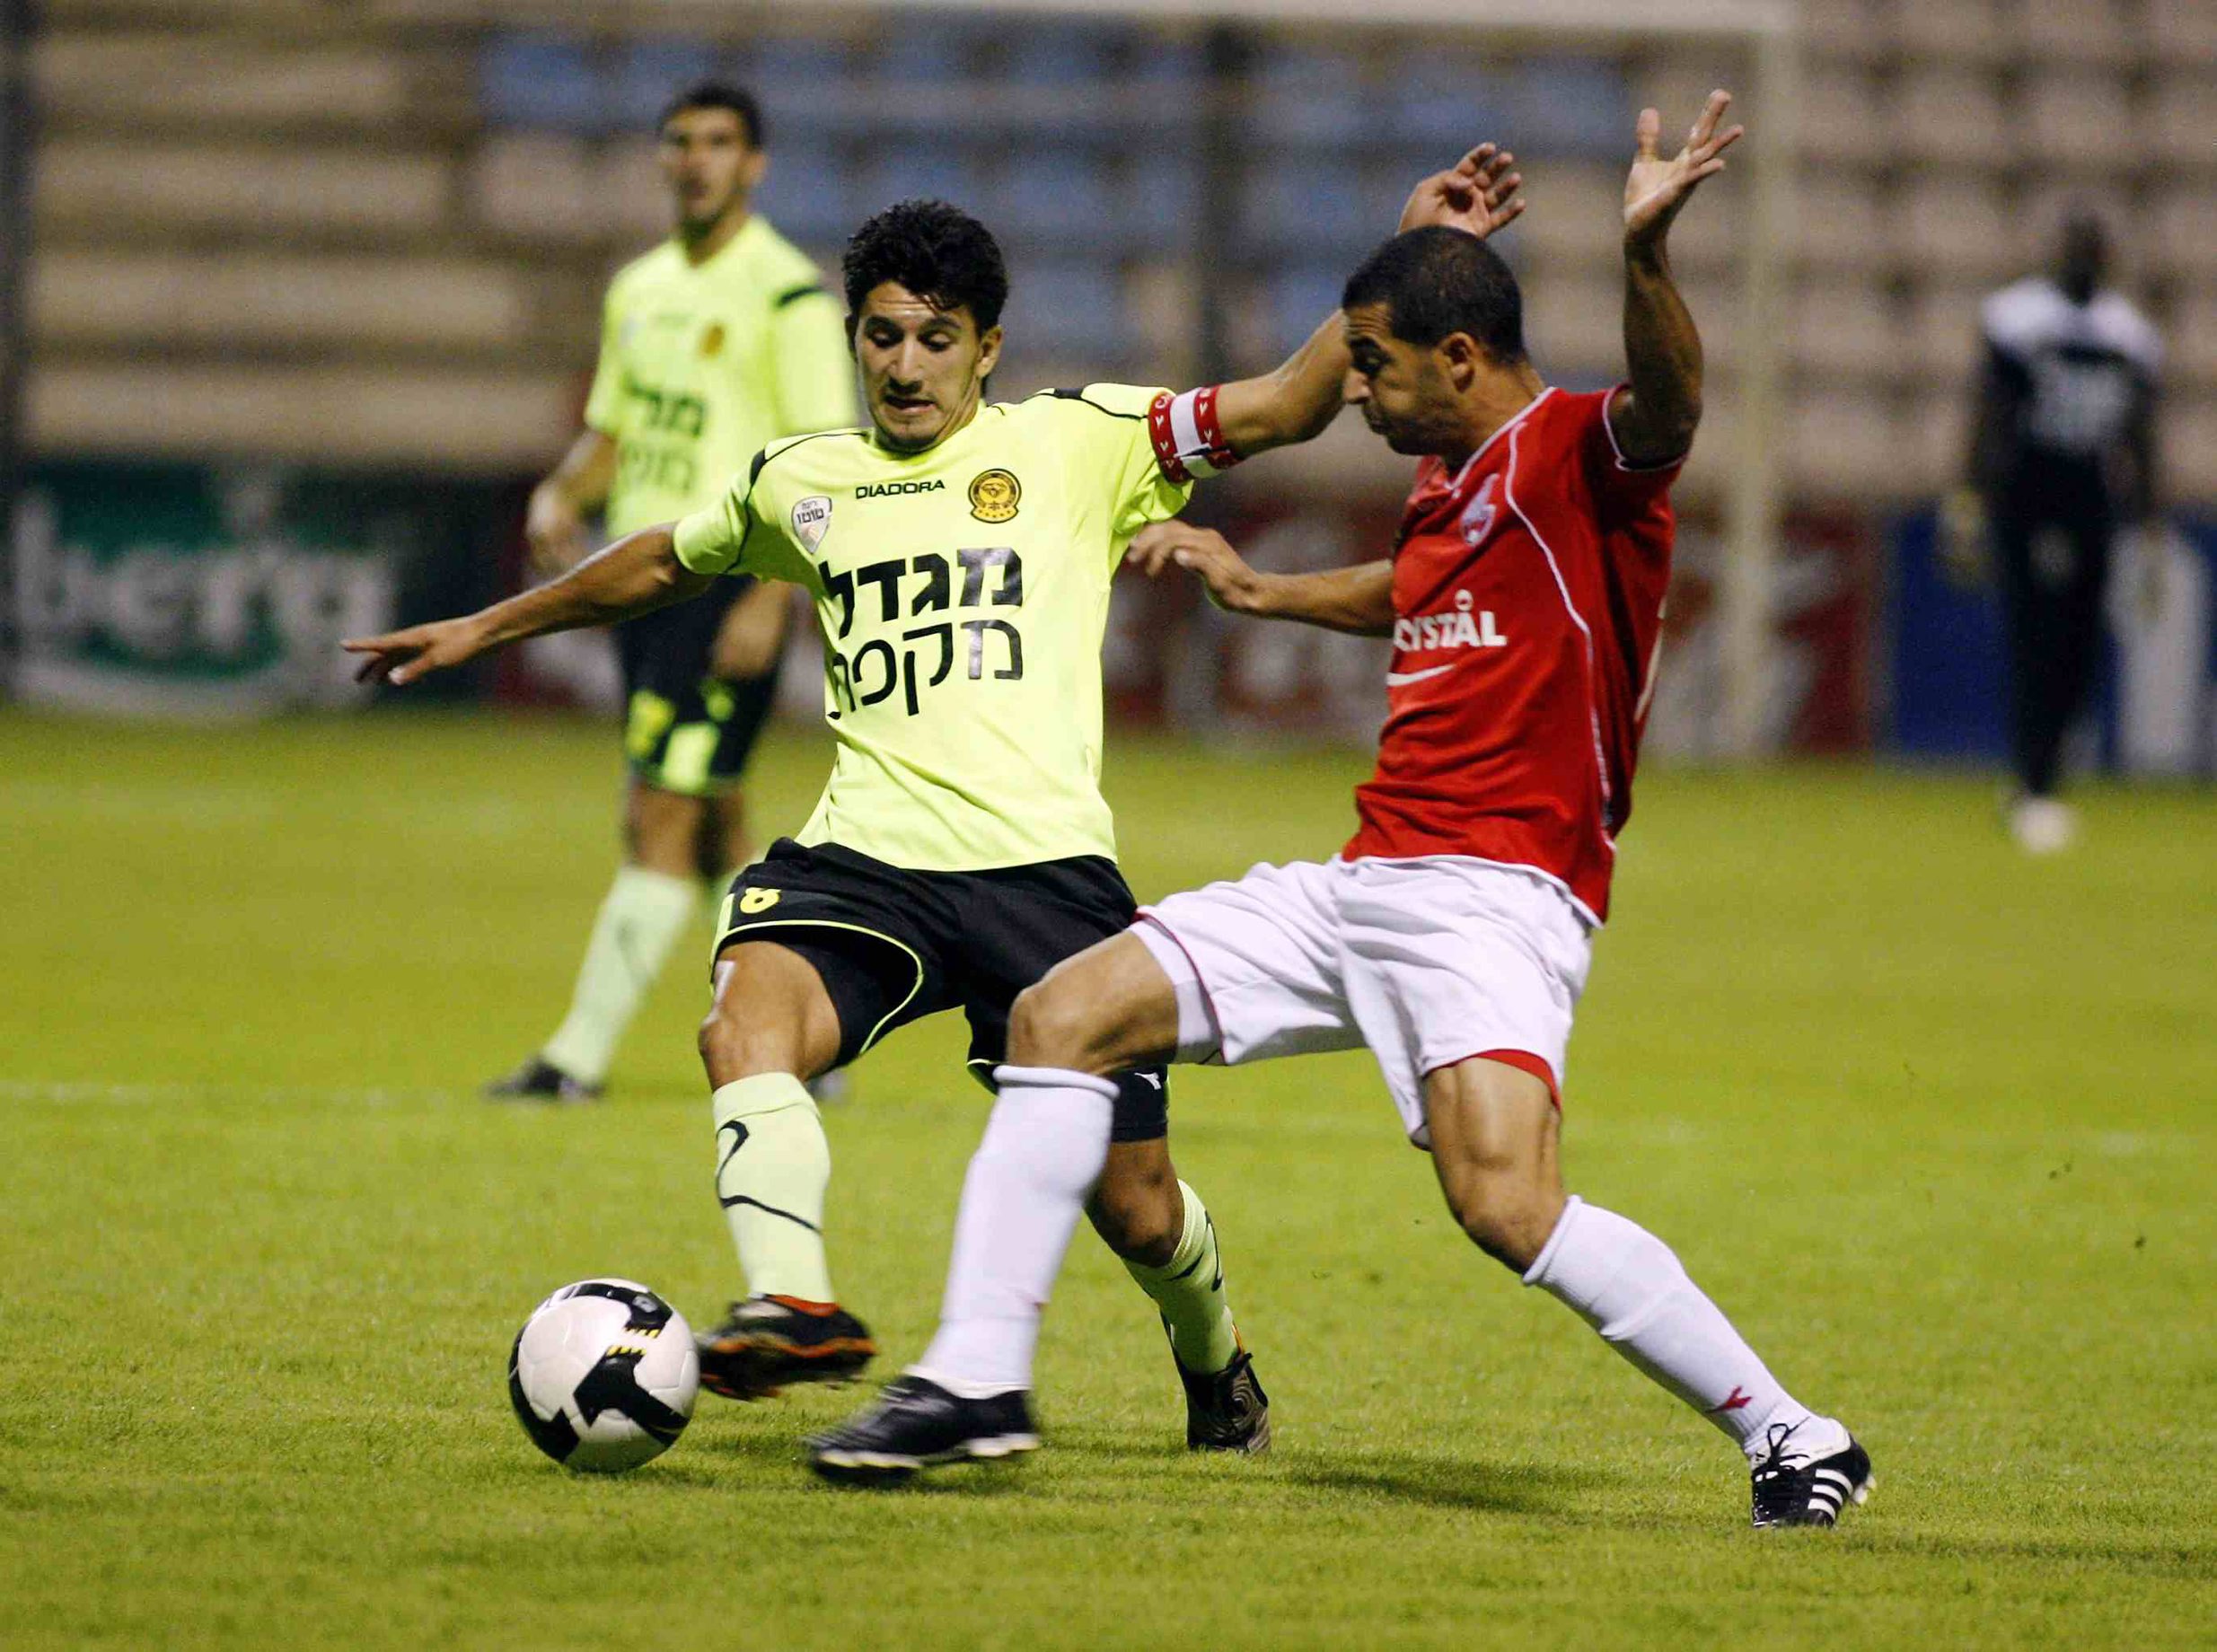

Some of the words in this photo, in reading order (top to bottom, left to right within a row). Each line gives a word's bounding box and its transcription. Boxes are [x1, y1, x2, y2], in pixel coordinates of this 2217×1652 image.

[856, 479, 946, 499] DIADORA
[818, 547, 1023, 640] מגדל
[827, 620, 1024, 720] מקפת
